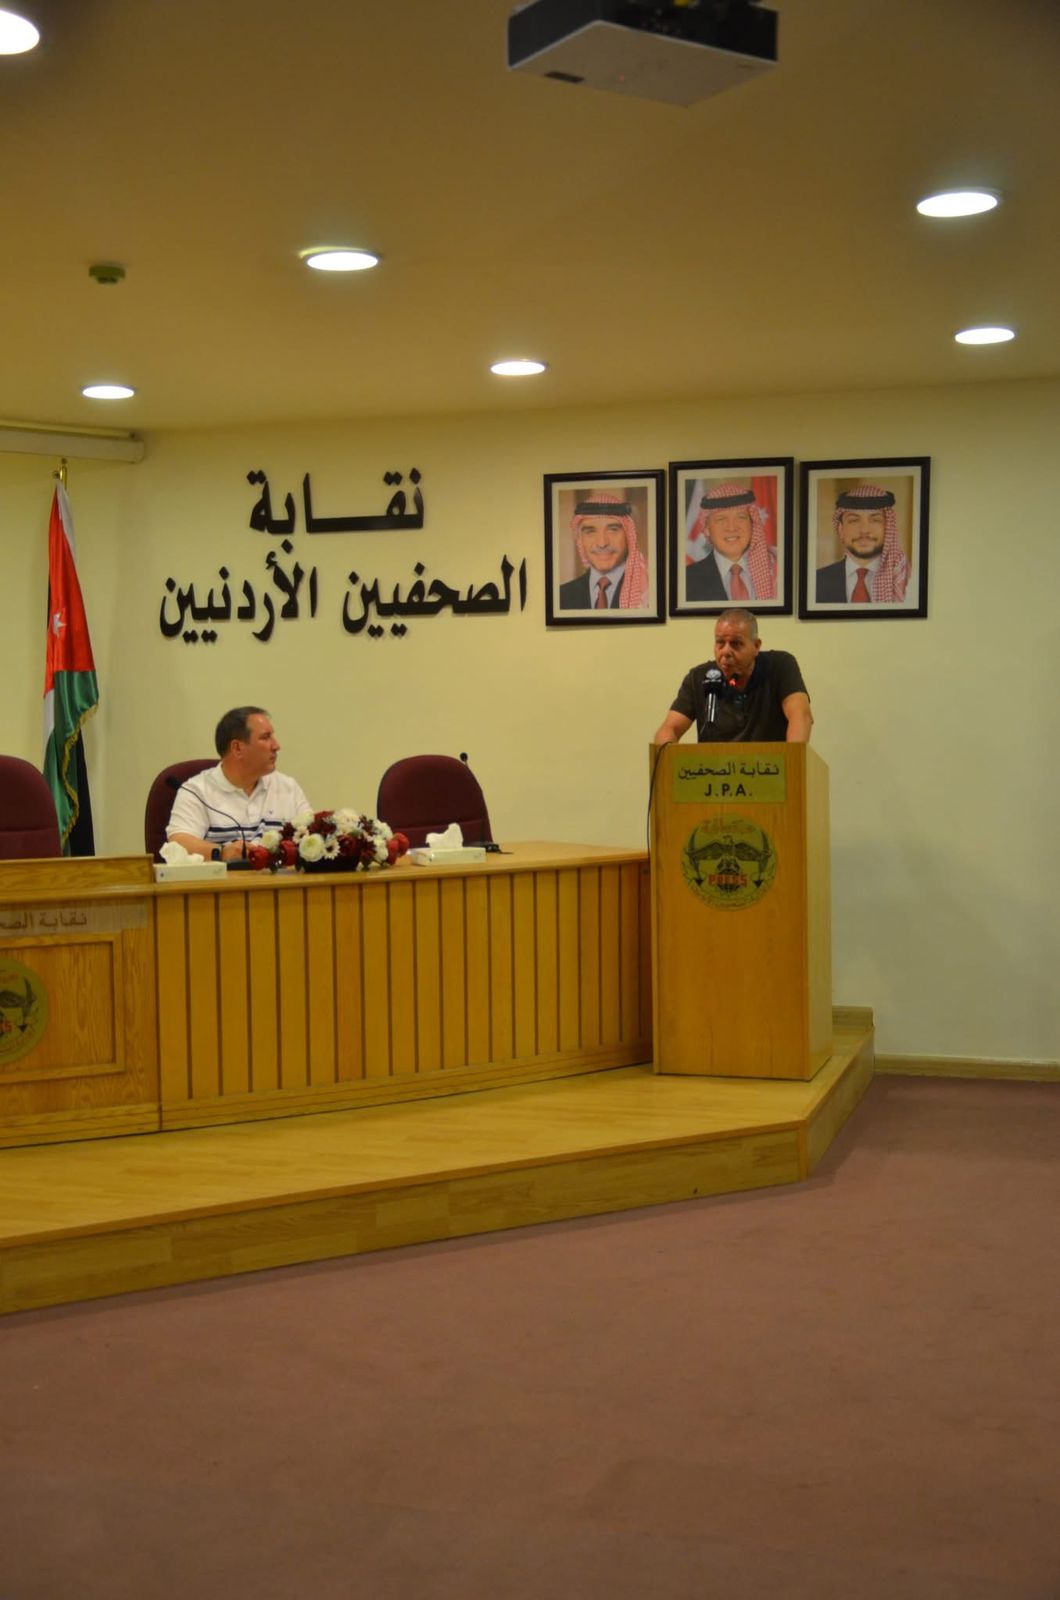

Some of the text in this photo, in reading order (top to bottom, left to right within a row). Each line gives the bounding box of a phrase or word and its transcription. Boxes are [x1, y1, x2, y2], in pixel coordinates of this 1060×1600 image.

[246, 467, 425, 554] نقابة
[159, 549, 528, 643] الصحفيين الأردنيين
[677, 761, 780, 780] نقابة الصحفيين
[708, 873, 748, 888] PRESS
[38, 911, 88, 931] نقابة
